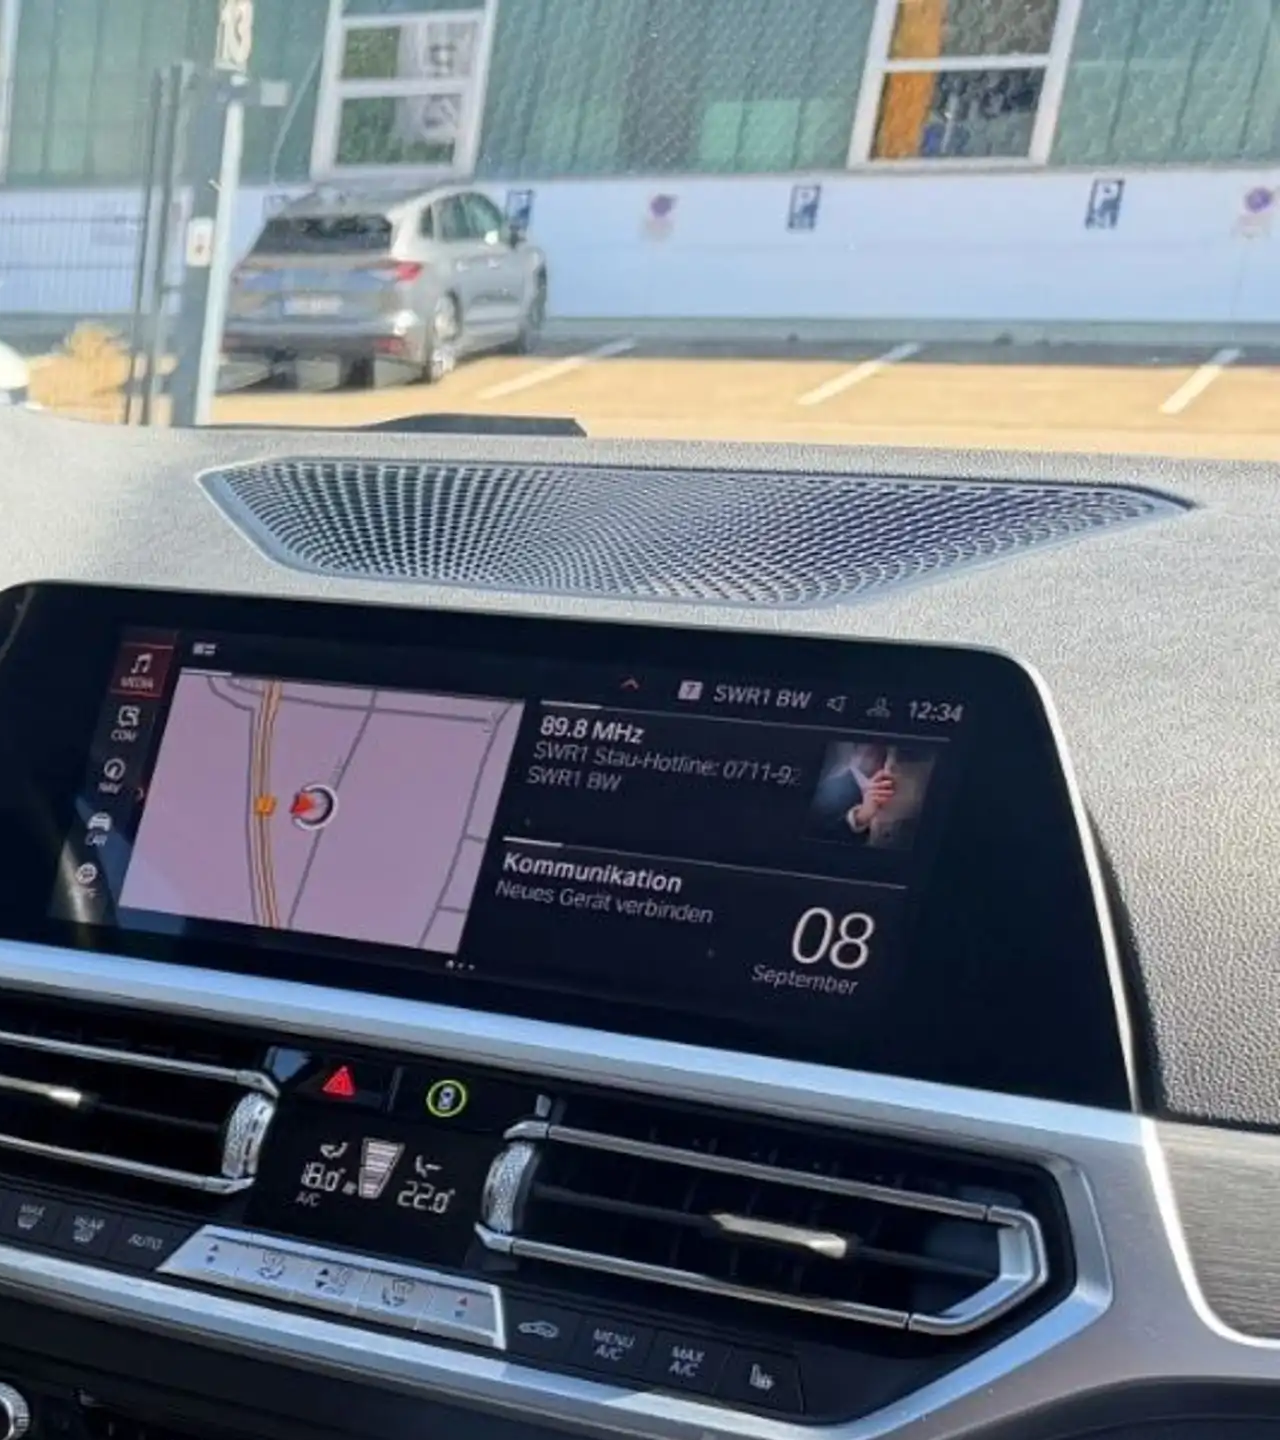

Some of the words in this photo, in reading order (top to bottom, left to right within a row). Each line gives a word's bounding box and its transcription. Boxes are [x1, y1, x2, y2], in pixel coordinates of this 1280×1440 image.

[713, 683, 771, 706] SWR1
[776, 688, 812, 709] BW
[908, 700, 964, 723] 12:34
[540, 714, 589, 740] 89.8
[591, 720, 645, 744] MHz
[533, 740, 589, 762] SWR1
[593, 748, 719, 775] Stau-Hotline:
[526, 765, 581, 787] SWR1
[587, 772, 622, 792] BW
[503, 851, 682, 894] Kommunikation
[495, 879, 554, 904] Neues
[559, 888, 611, 913] Gerät
[615, 898, 713, 925] verbinden
[791, 906, 876, 971] 08
[751, 963, 859, 997] September
[127, 1232, 164, 1251] AUTO
[593, 1327, 636, 1348] MENU
[594, 1344, 623, 1362] A/C
[671, 1345, 706, 1363] MAX
[669, 1360, 700, 1378] A/C
